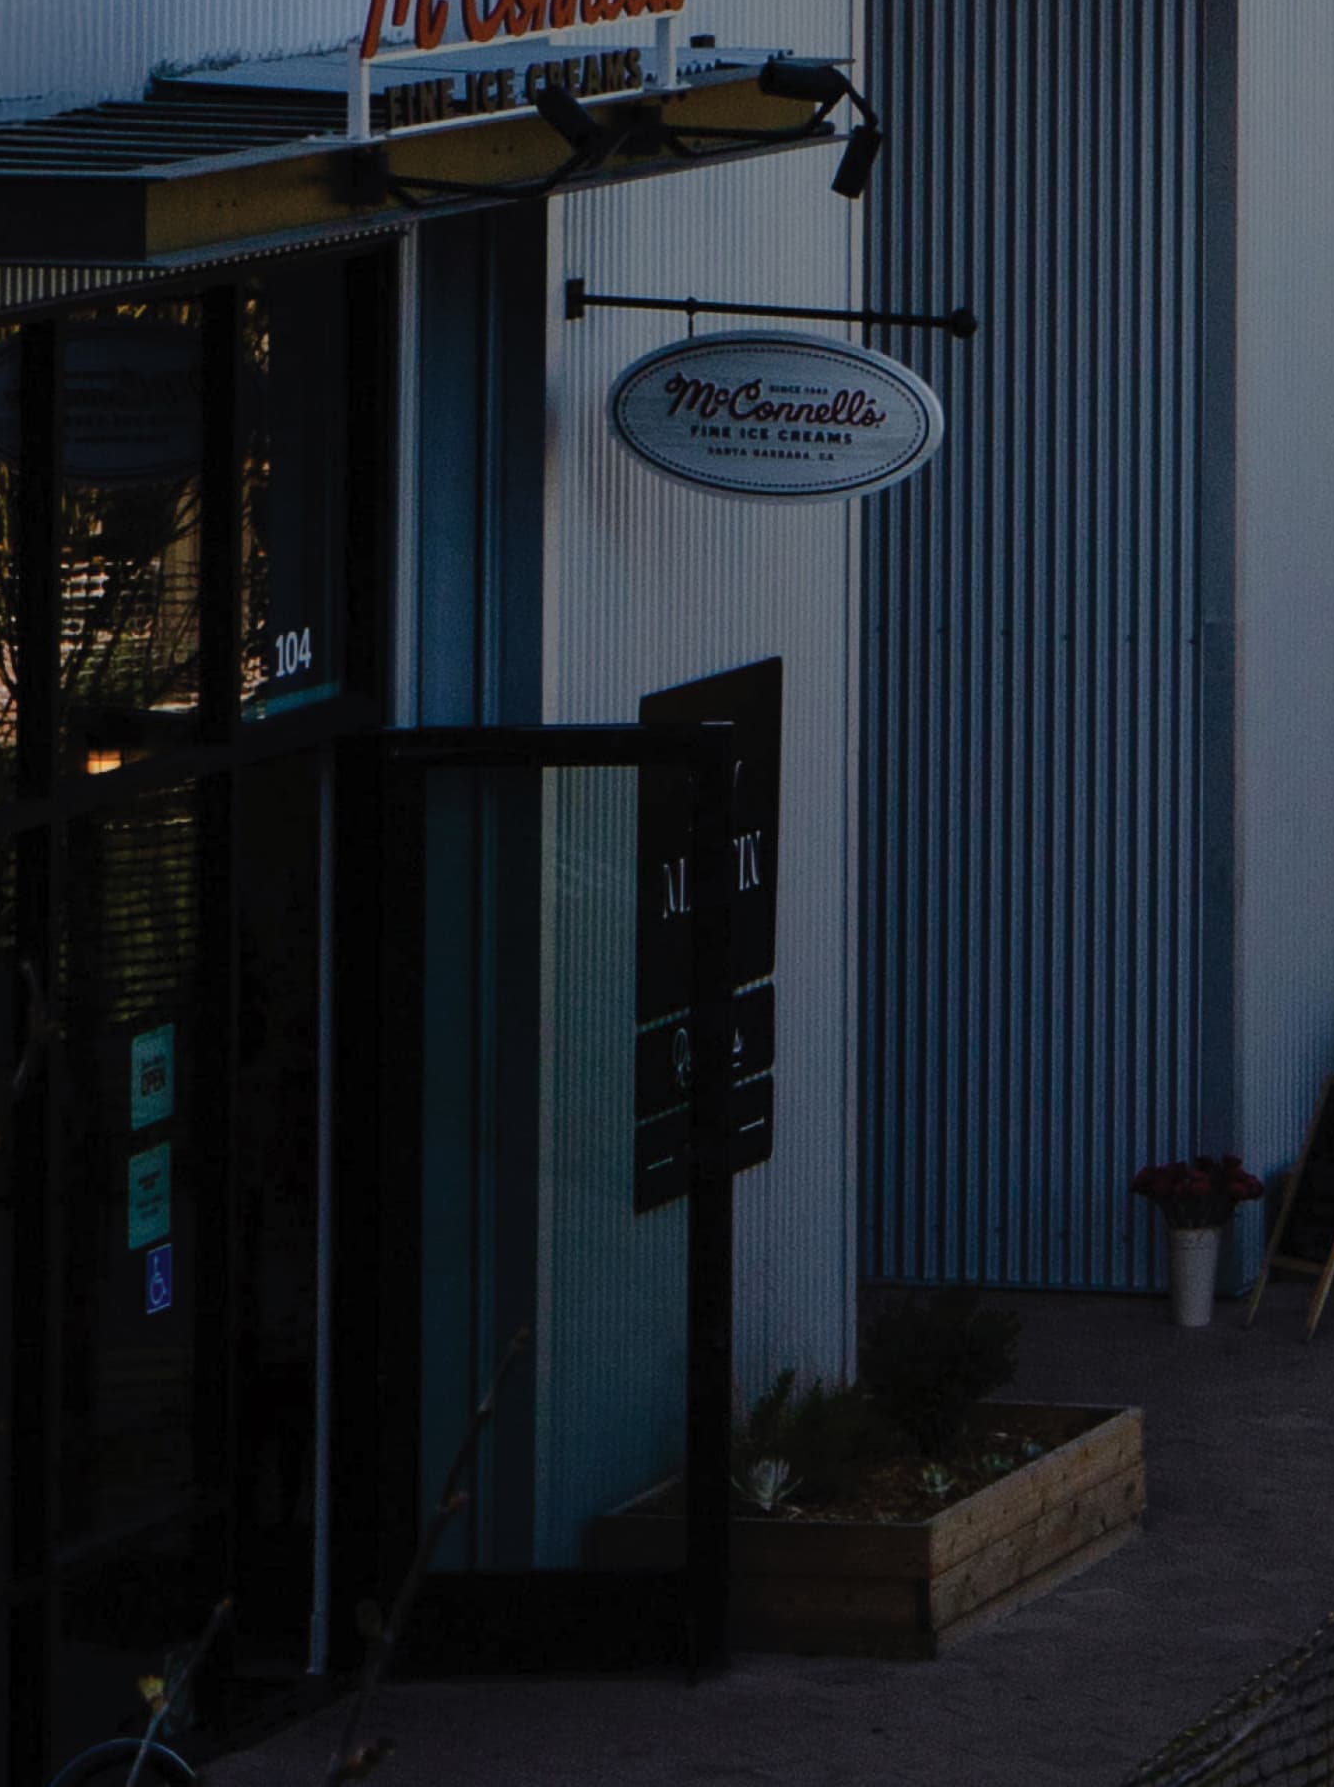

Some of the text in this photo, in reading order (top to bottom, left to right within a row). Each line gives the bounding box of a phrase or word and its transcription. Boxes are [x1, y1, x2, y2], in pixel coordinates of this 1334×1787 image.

[384, 47, 642, 129] FINE ICE CREAMS
[665, 372, 886, 428] McConnell's
[690, 425, 853, 445] FINE ICE CREAMS
[707, 446, 748, 457] SANTA
[275, 627, 312, 677] 104
